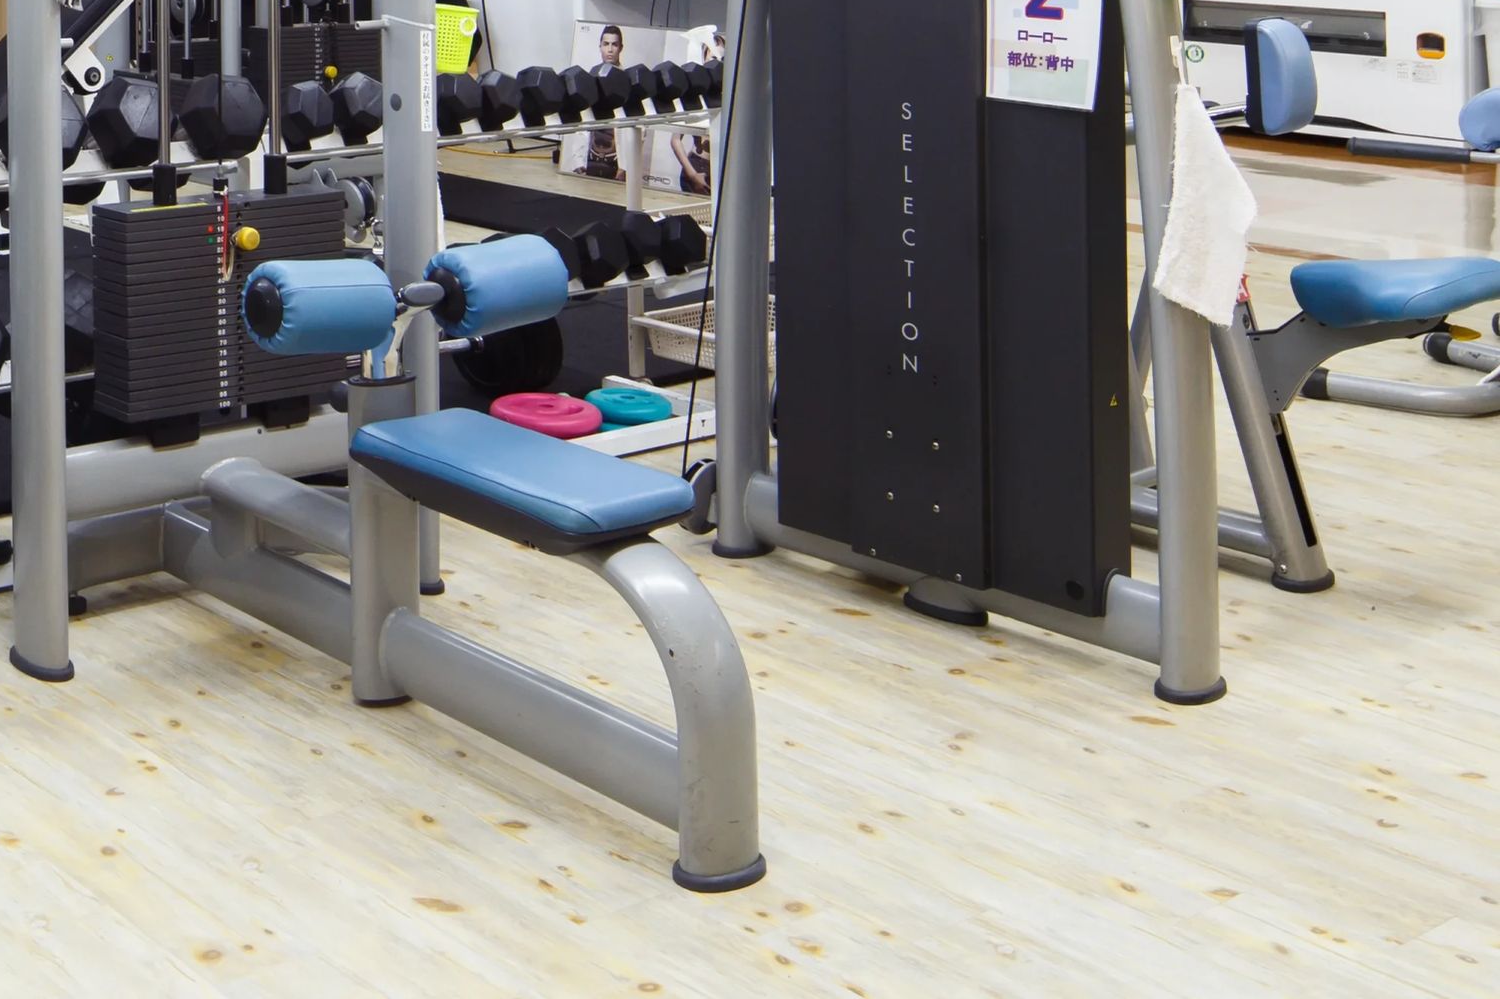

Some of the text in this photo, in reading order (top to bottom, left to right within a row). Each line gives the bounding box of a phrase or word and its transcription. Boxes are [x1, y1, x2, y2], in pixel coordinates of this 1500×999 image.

[1017, 29, 1068, 44] ローロー
[901, 102, 919, 374] SELECTION
